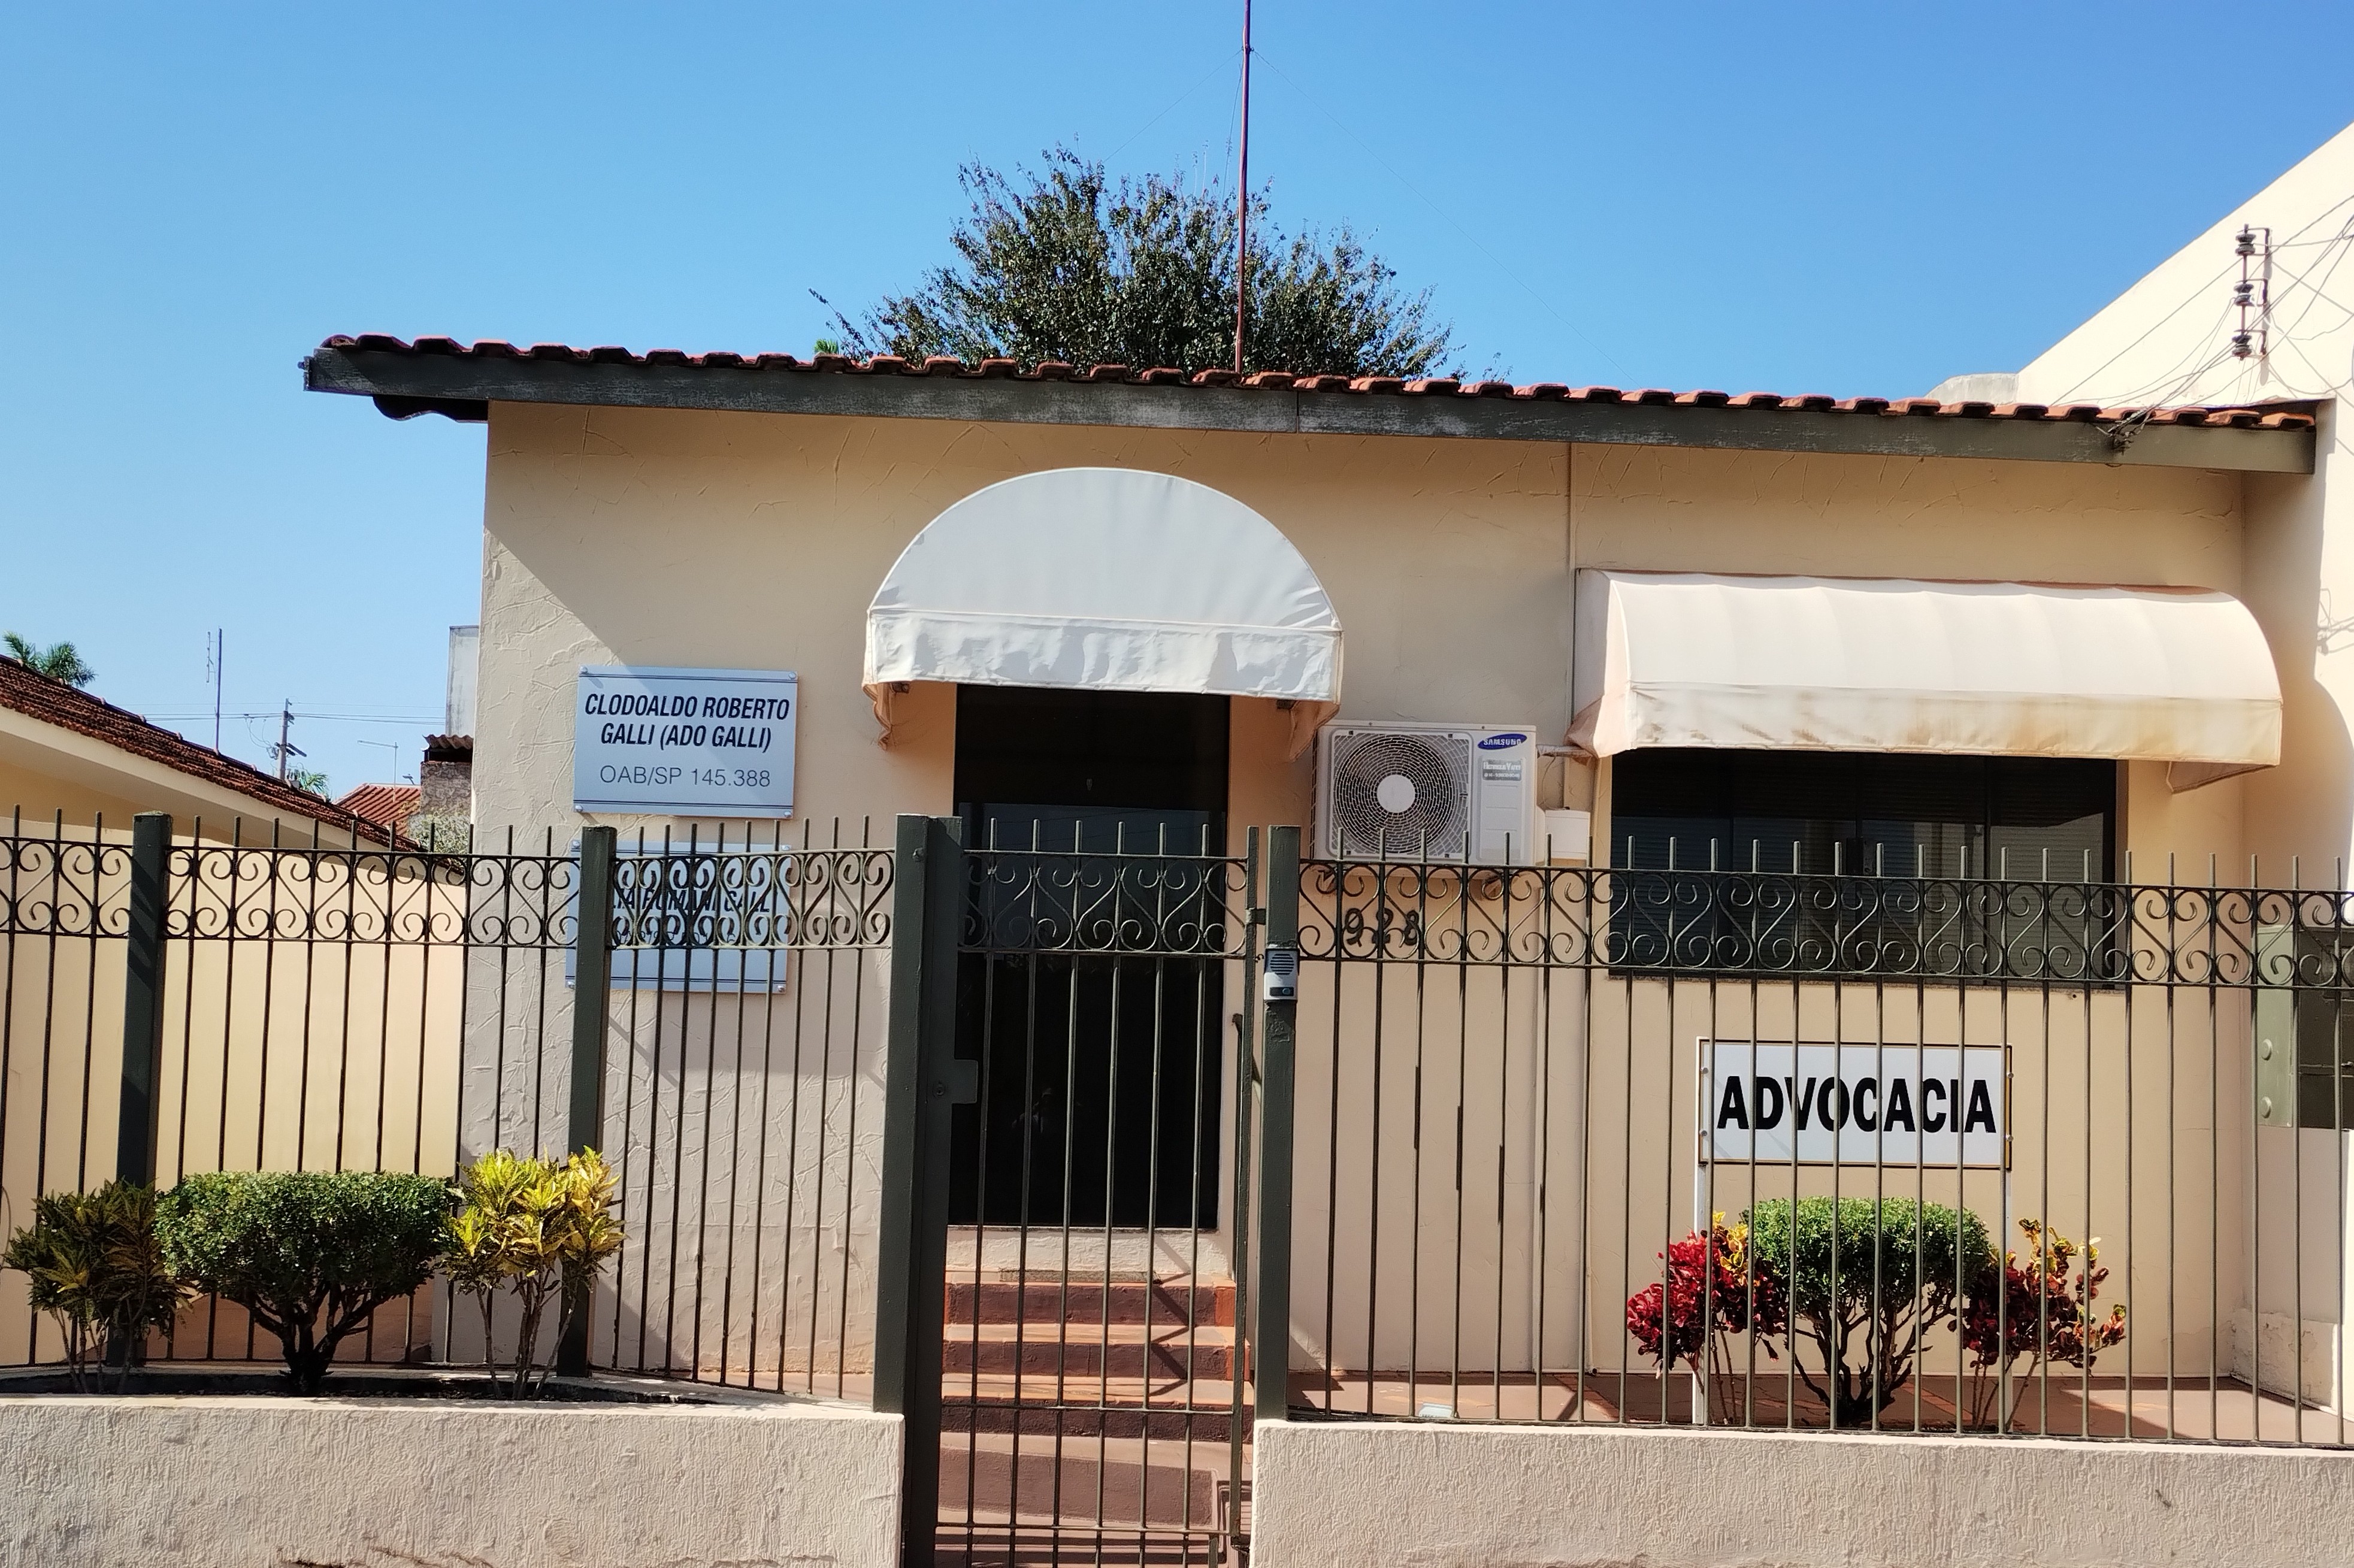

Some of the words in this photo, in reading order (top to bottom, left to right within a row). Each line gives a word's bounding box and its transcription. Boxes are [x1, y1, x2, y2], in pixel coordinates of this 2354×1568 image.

[585, 694, 697, 717] CLODOALDO
[702, 697, 789, 720] ROBERTO
[601, 723, 655, 745] GALLI
[659, 724, 707, 750] (ADO
[712, 726, 771, 753] GALLI)
[600, 765, 682, 786] OAB/SP
[691, 768, 770, 787] 145.388
[1717, 1076, 1996, 1133] ADVOCACIA
